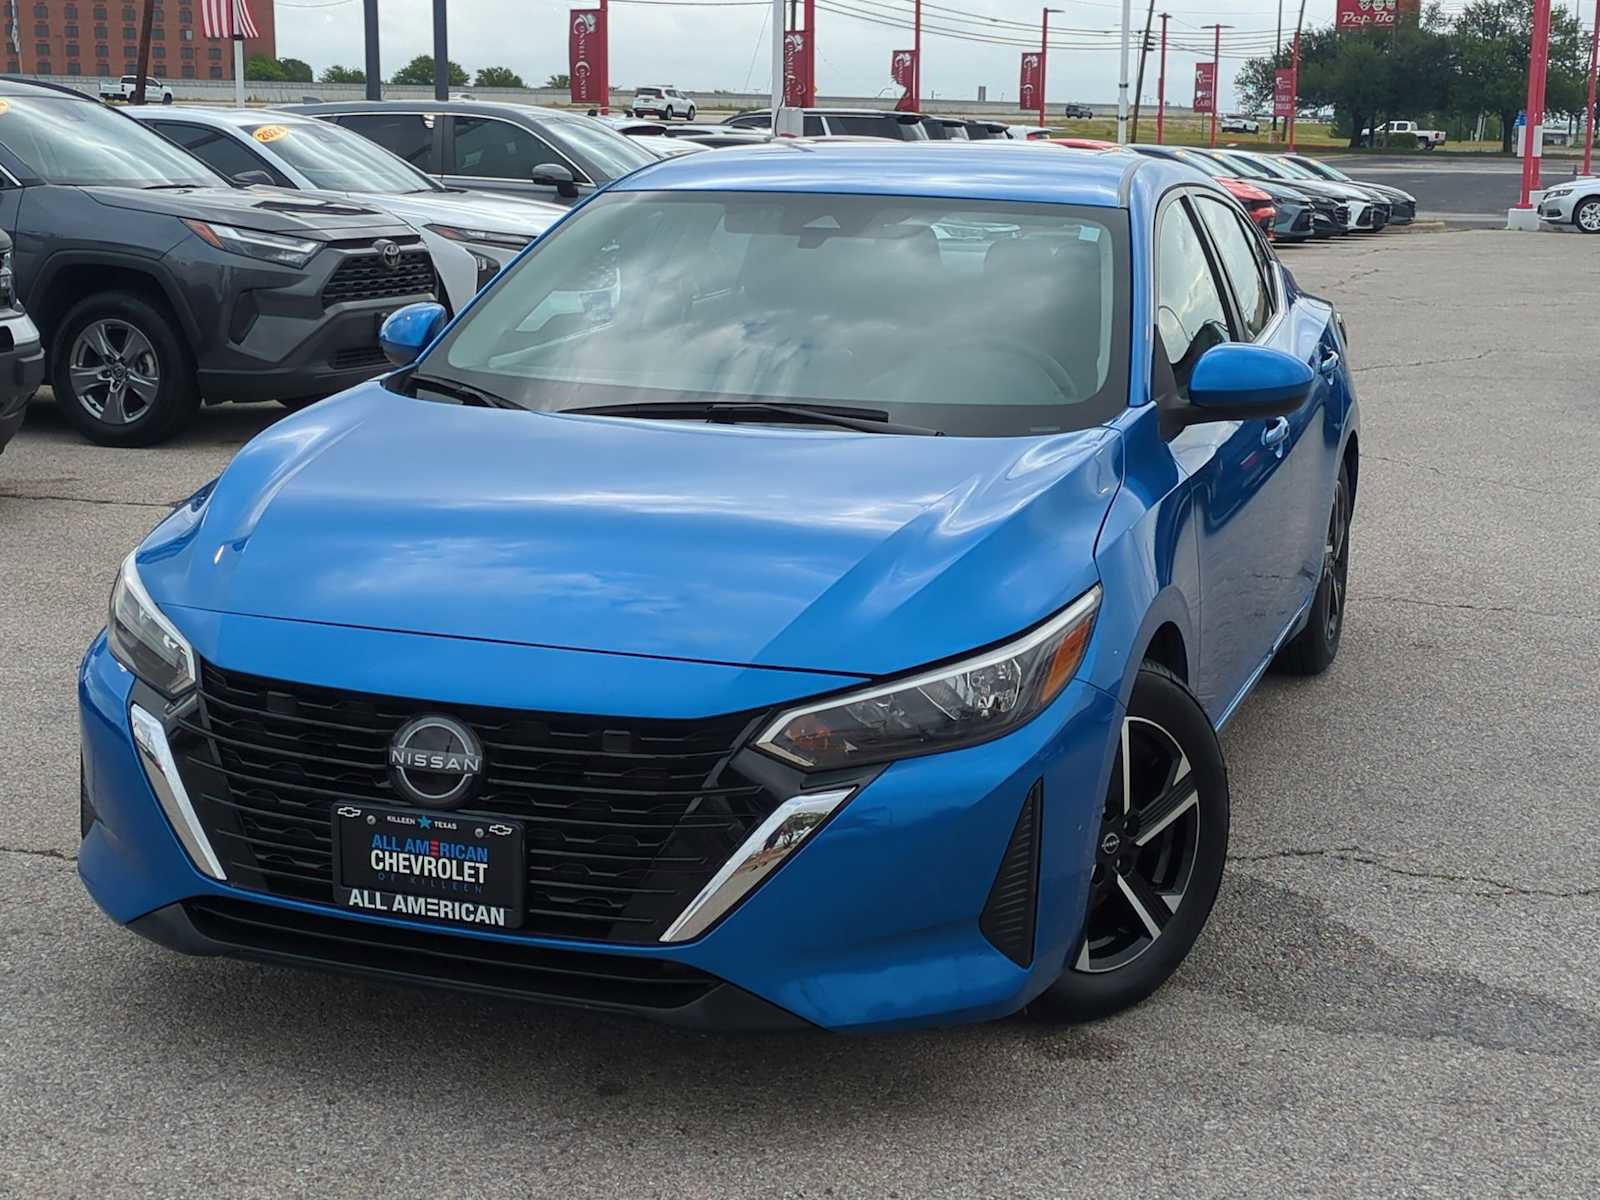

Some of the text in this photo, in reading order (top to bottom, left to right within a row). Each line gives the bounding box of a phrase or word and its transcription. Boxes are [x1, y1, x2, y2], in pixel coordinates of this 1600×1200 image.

[1342, 11, 1395, 24] Pep Bo
[392, 750, 479, 771] NISSAN
[387, 815, 457, 830] KILLEEN TEXAS
[371, 834, 488, 862] ALL AMERICAN
[370, 849, 489, 884] CHEVROLET
[349, 888, 505, 926] ALL AMERICAN
